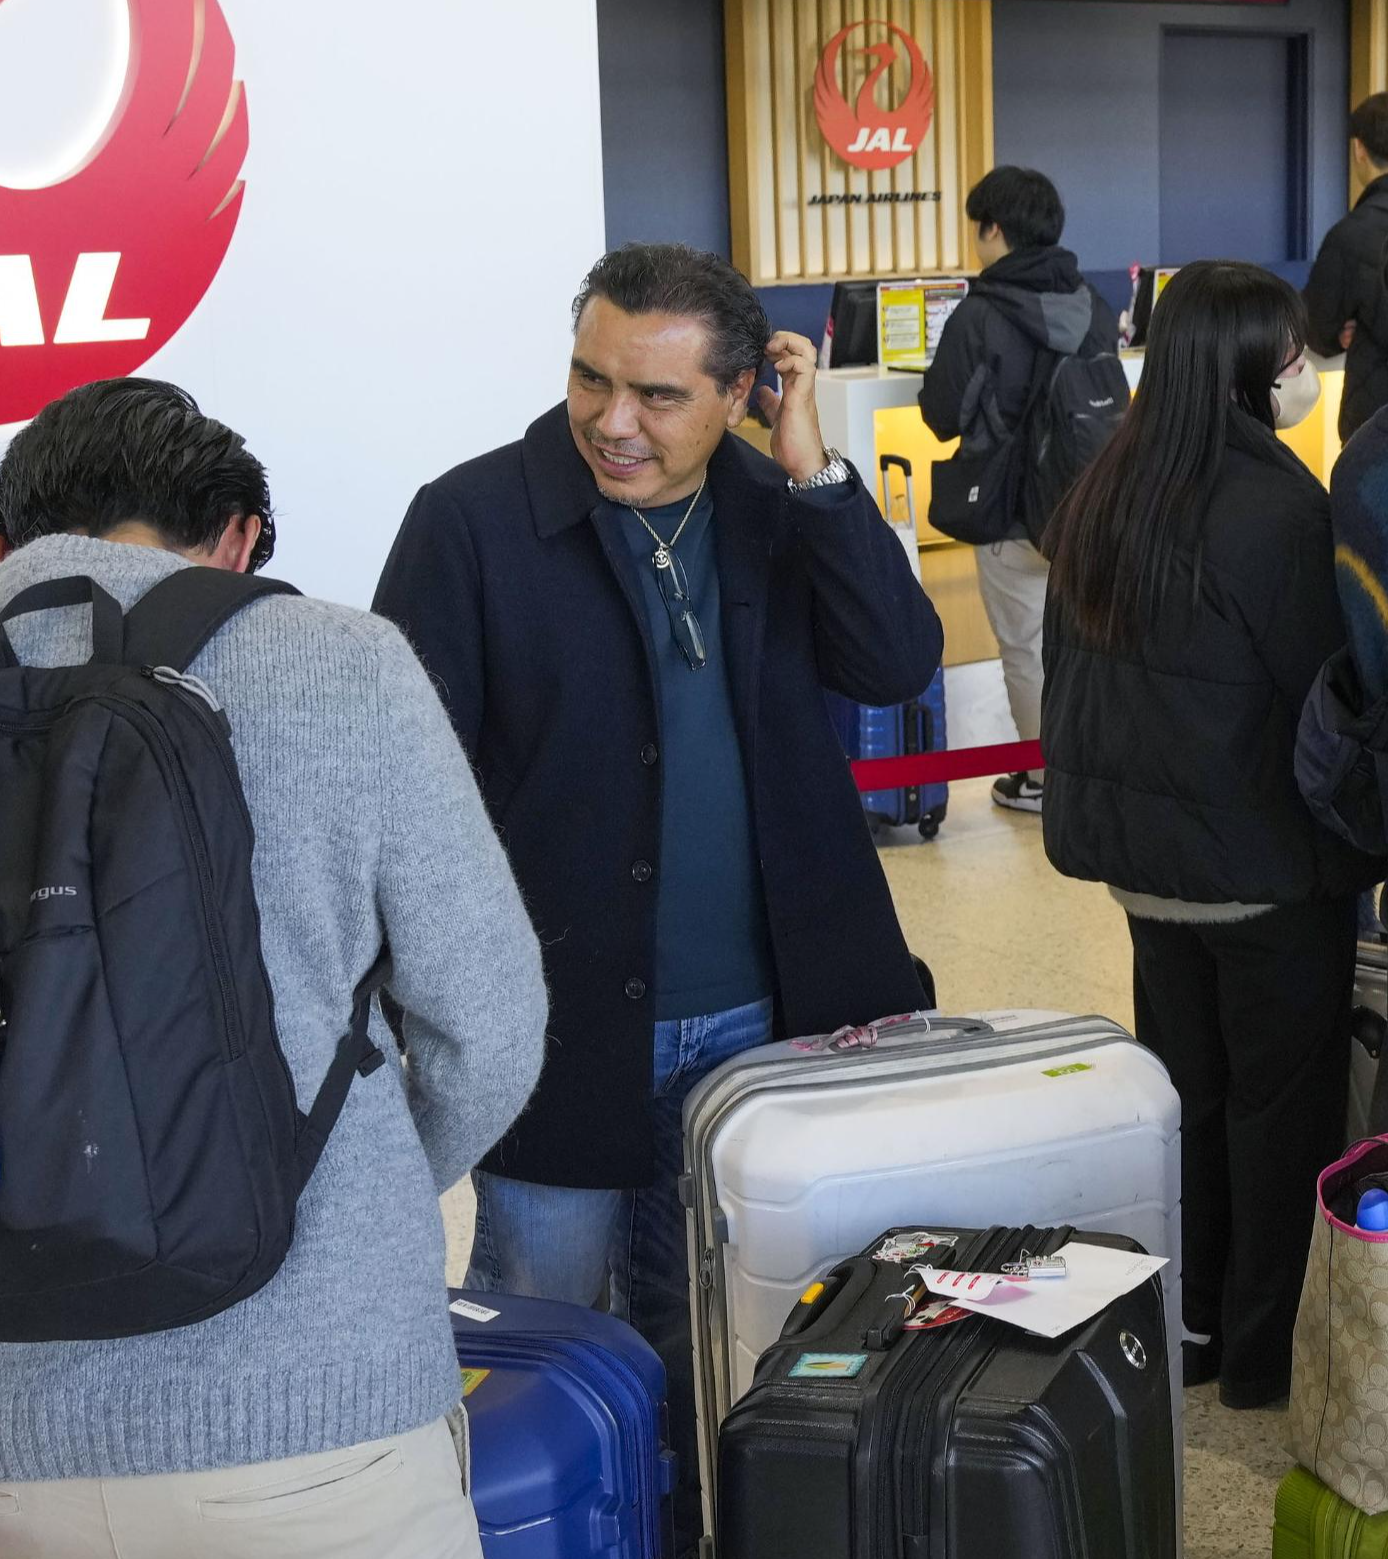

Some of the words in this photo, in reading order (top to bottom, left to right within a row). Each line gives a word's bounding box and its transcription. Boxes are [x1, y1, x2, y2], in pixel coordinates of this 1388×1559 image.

[847, 127, 912, 152] JAL
[807, 193, 862, 206] JAPAN
[865, 191, 941, 204] AIRLINES
